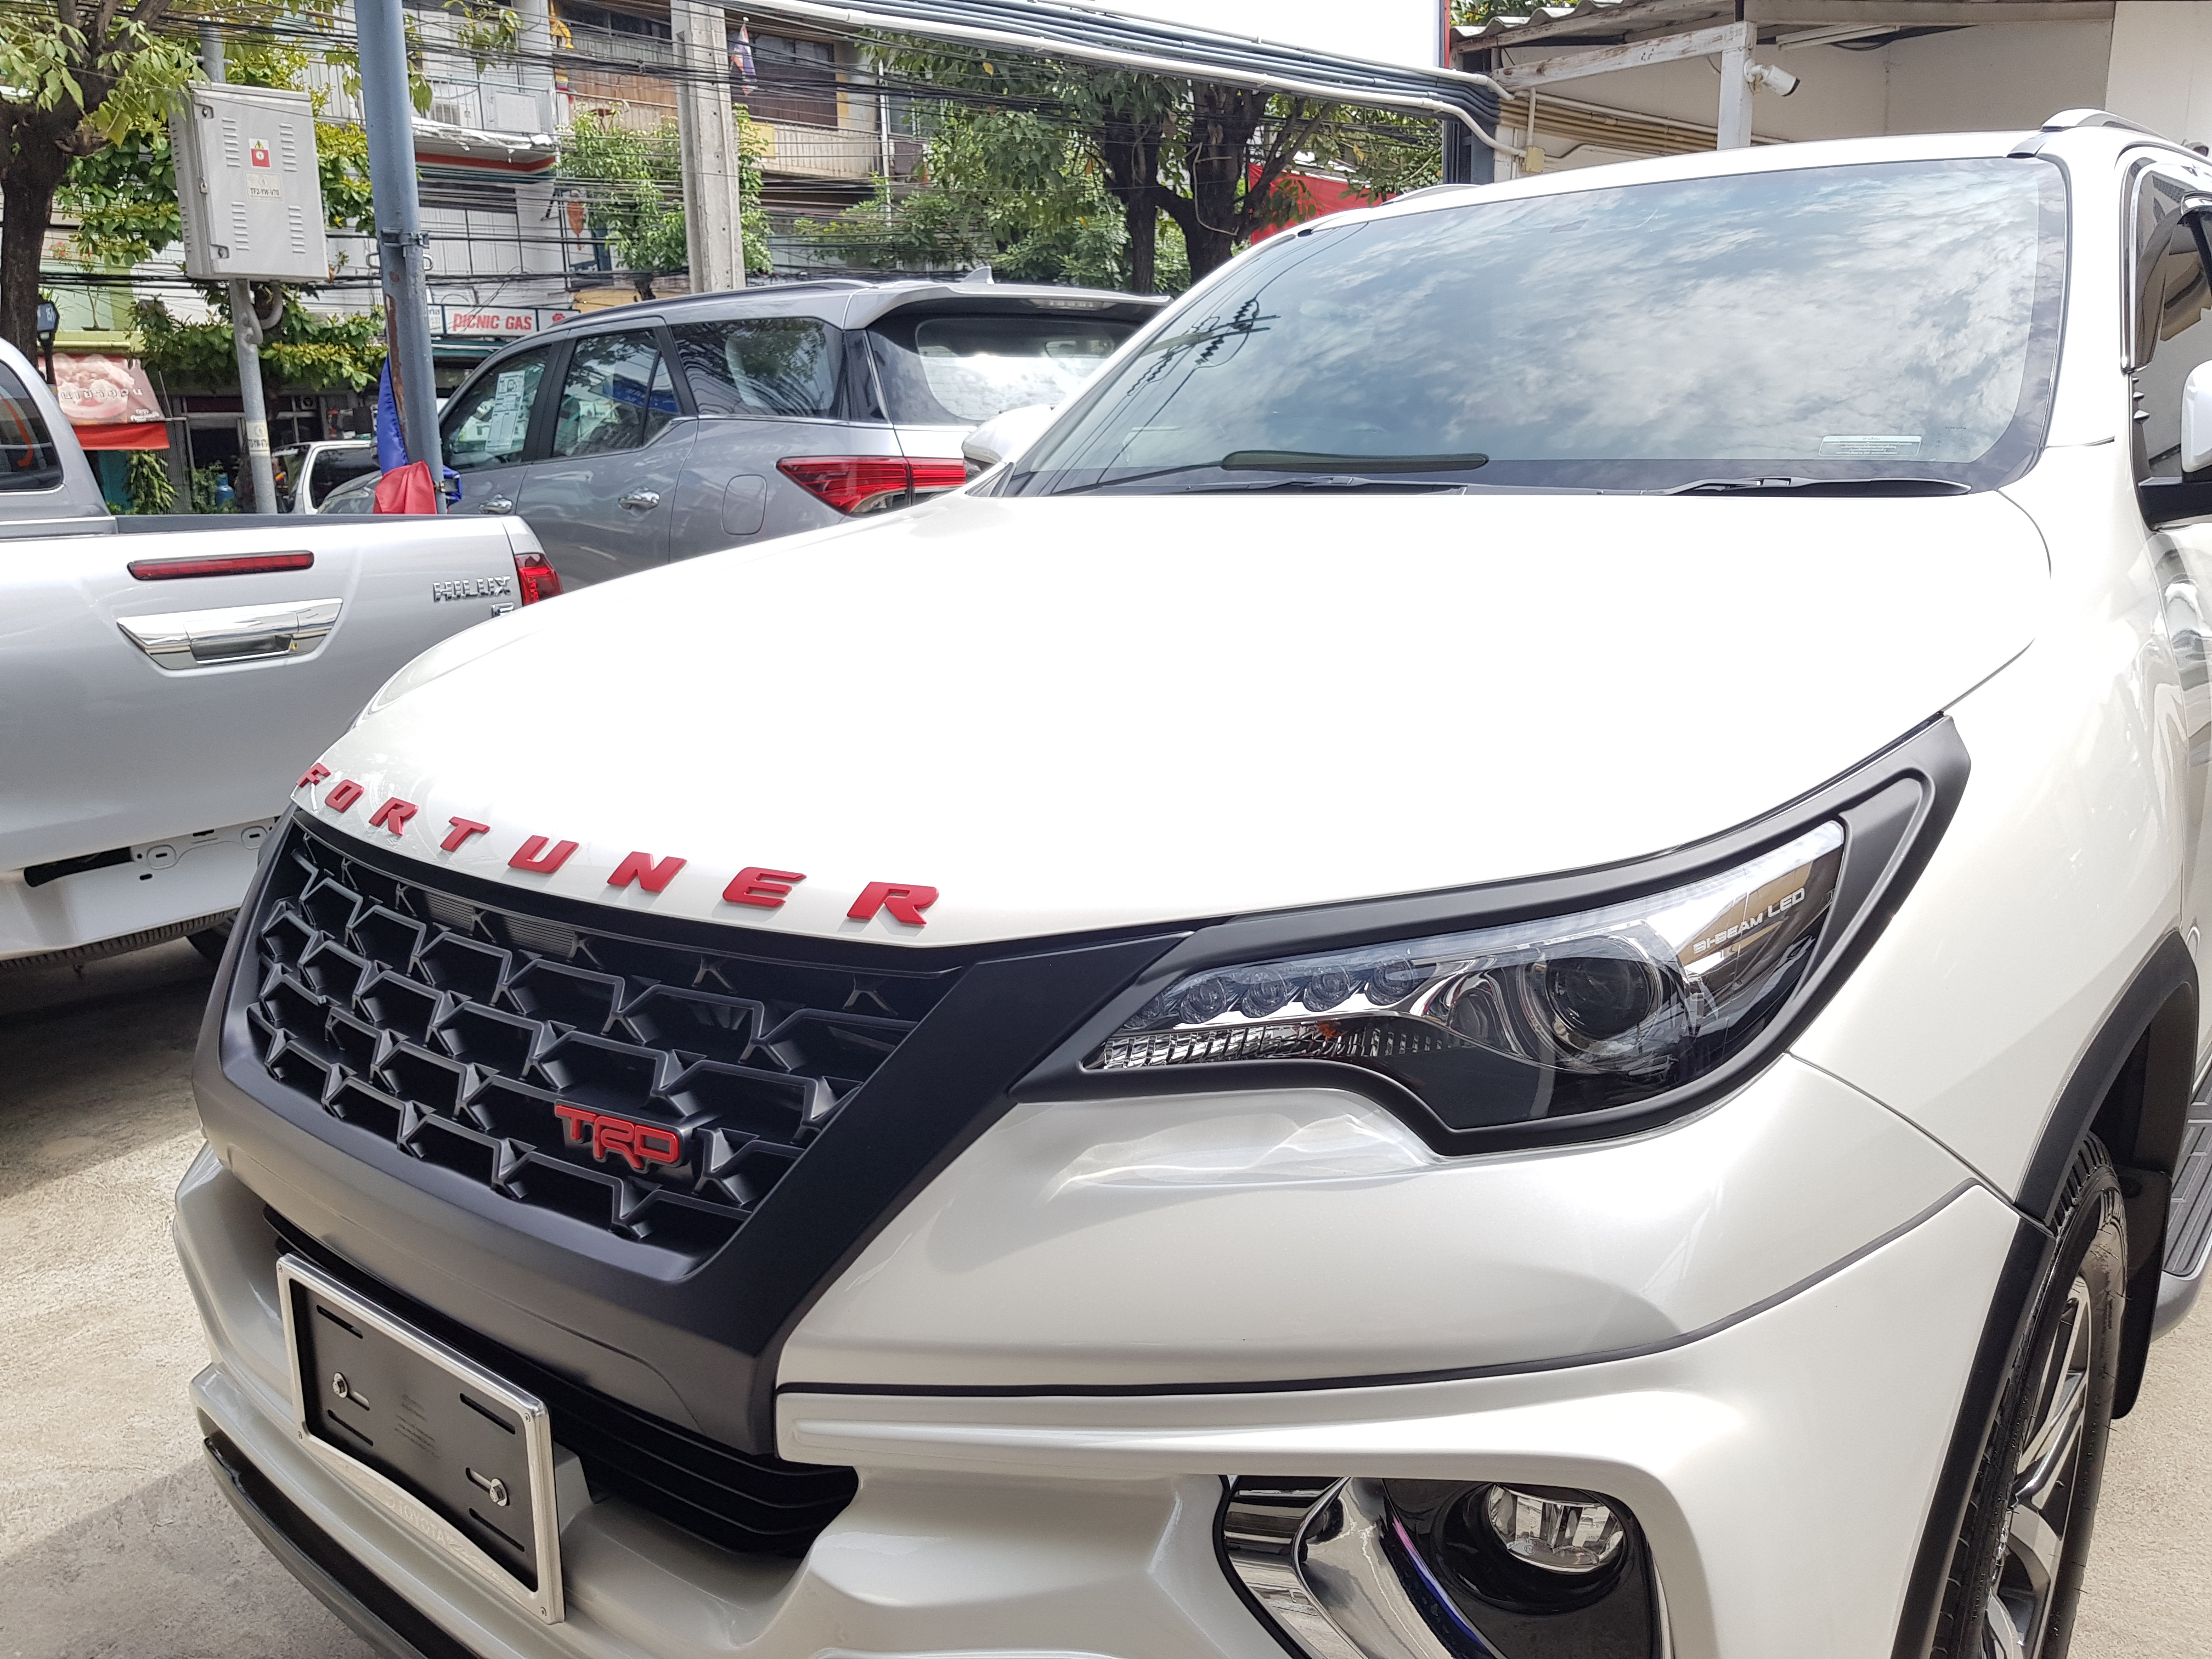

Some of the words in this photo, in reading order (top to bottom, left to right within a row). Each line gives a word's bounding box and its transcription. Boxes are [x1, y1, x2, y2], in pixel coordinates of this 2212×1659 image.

[453, 313, 499, 331] PICNIC
[505, 315, 532, 330] GAS
[433, 576, 511, 602] HILUX
[296, 763, 940, 925] FORTUNER
[1694, 912, 1764, 955] BI-BEAM
[1768, 887, 1805, 918] LED
[555, 1104, 679, 1169] TRD
[398, 1500, 447, 1545] TOYOTA
